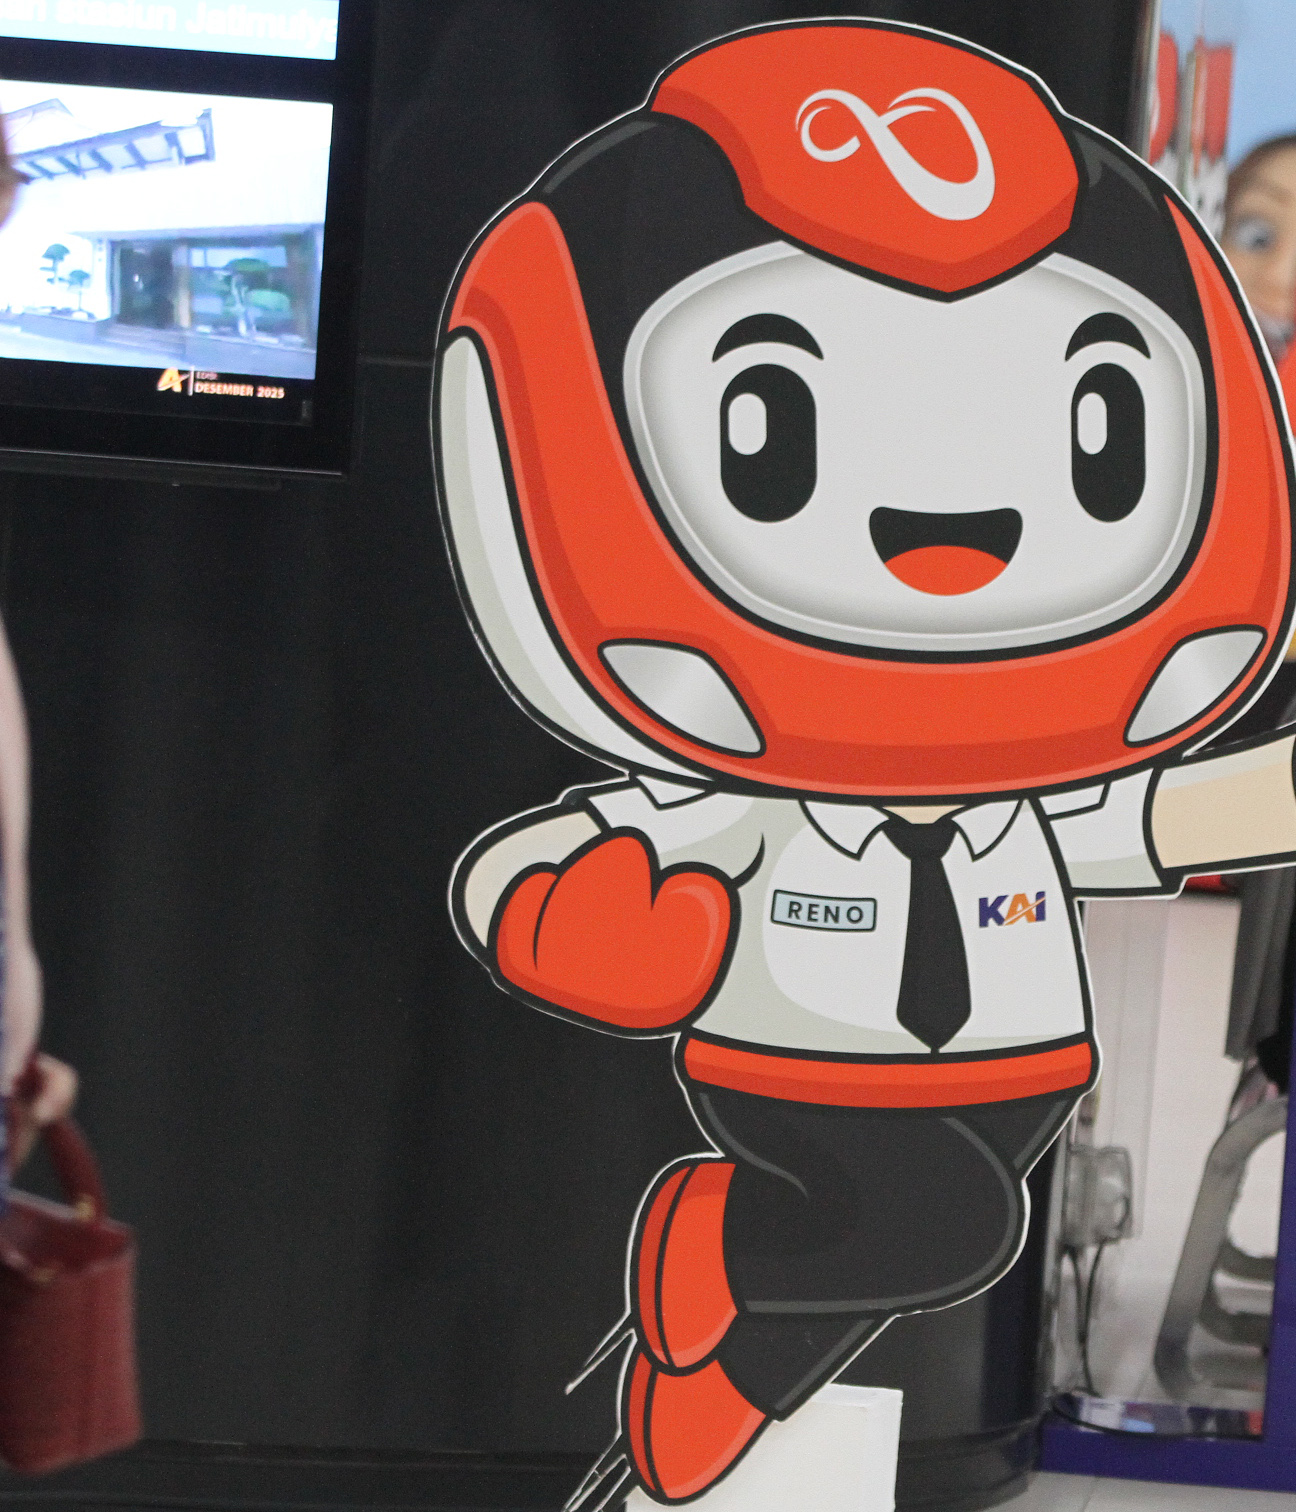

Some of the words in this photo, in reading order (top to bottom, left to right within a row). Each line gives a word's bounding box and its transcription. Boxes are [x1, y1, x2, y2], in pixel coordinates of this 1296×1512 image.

[194, 382, 254, 397] DESEMBER
[256, 386, 285, 399] 2025
[788, 901, 863, 924] RENO
[979, 891, 1046, 928] KAI
